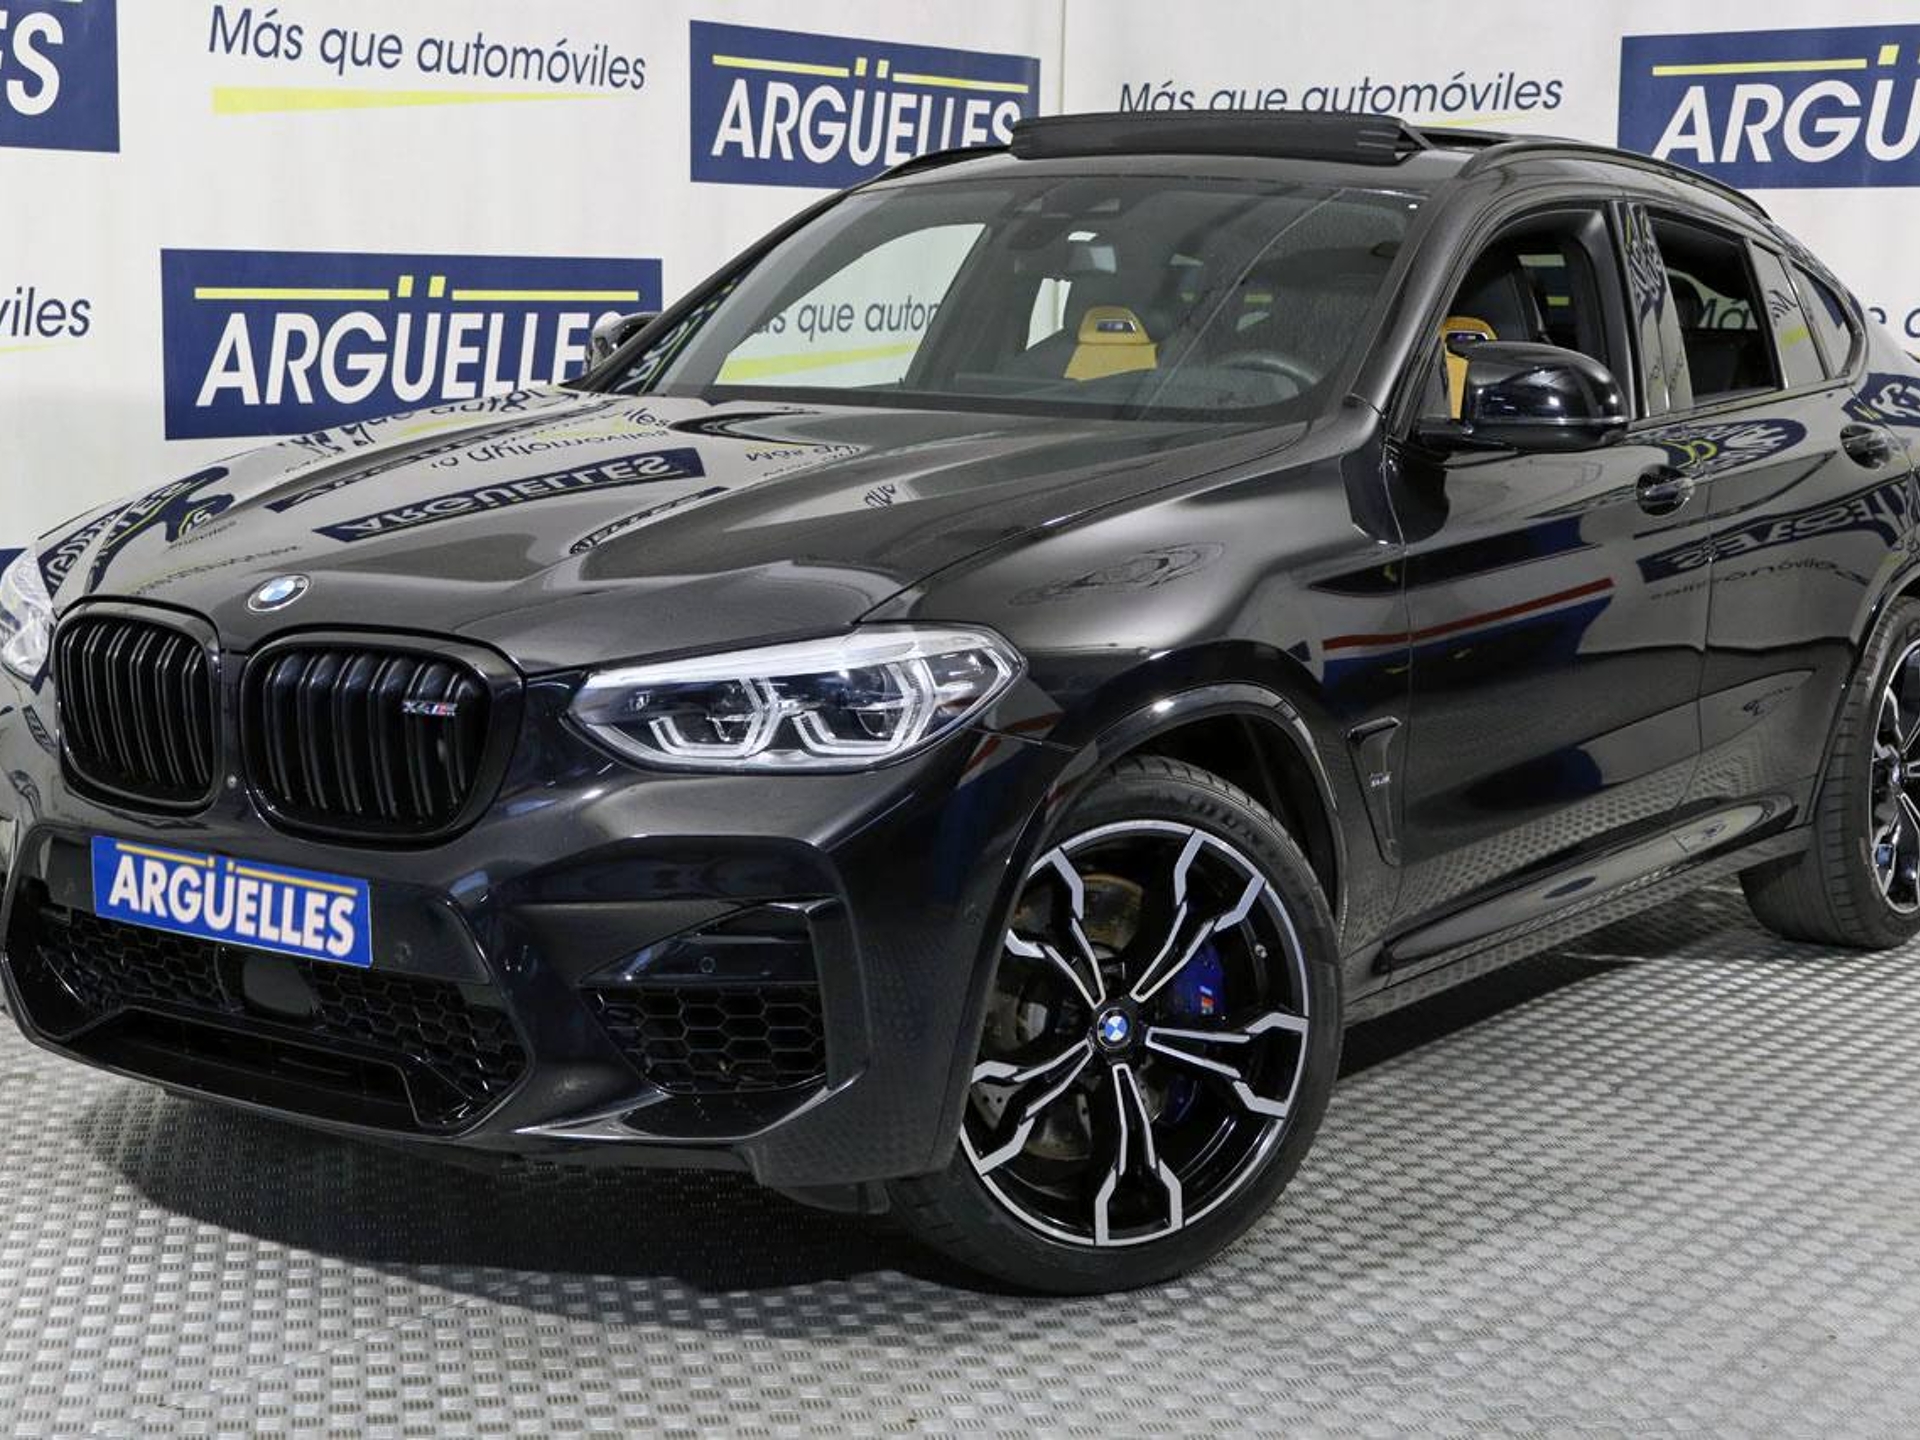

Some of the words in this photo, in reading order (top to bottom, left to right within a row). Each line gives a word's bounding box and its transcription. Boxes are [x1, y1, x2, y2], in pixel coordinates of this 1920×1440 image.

[0, 10, 64, 116] S
[208, 5, 302, 60] Más
[320, 28, 402, 76] que
[417, 32, 646, 90] automóviles
[1119, 80, 1195, 112] Más
[1301, 72, 1564, 114] automóviles
[196, 275, 623, 407] ARGÜELLE
[797, 303, 855, 342] que
[109, 854, 356, 957] ARGÜELLES
